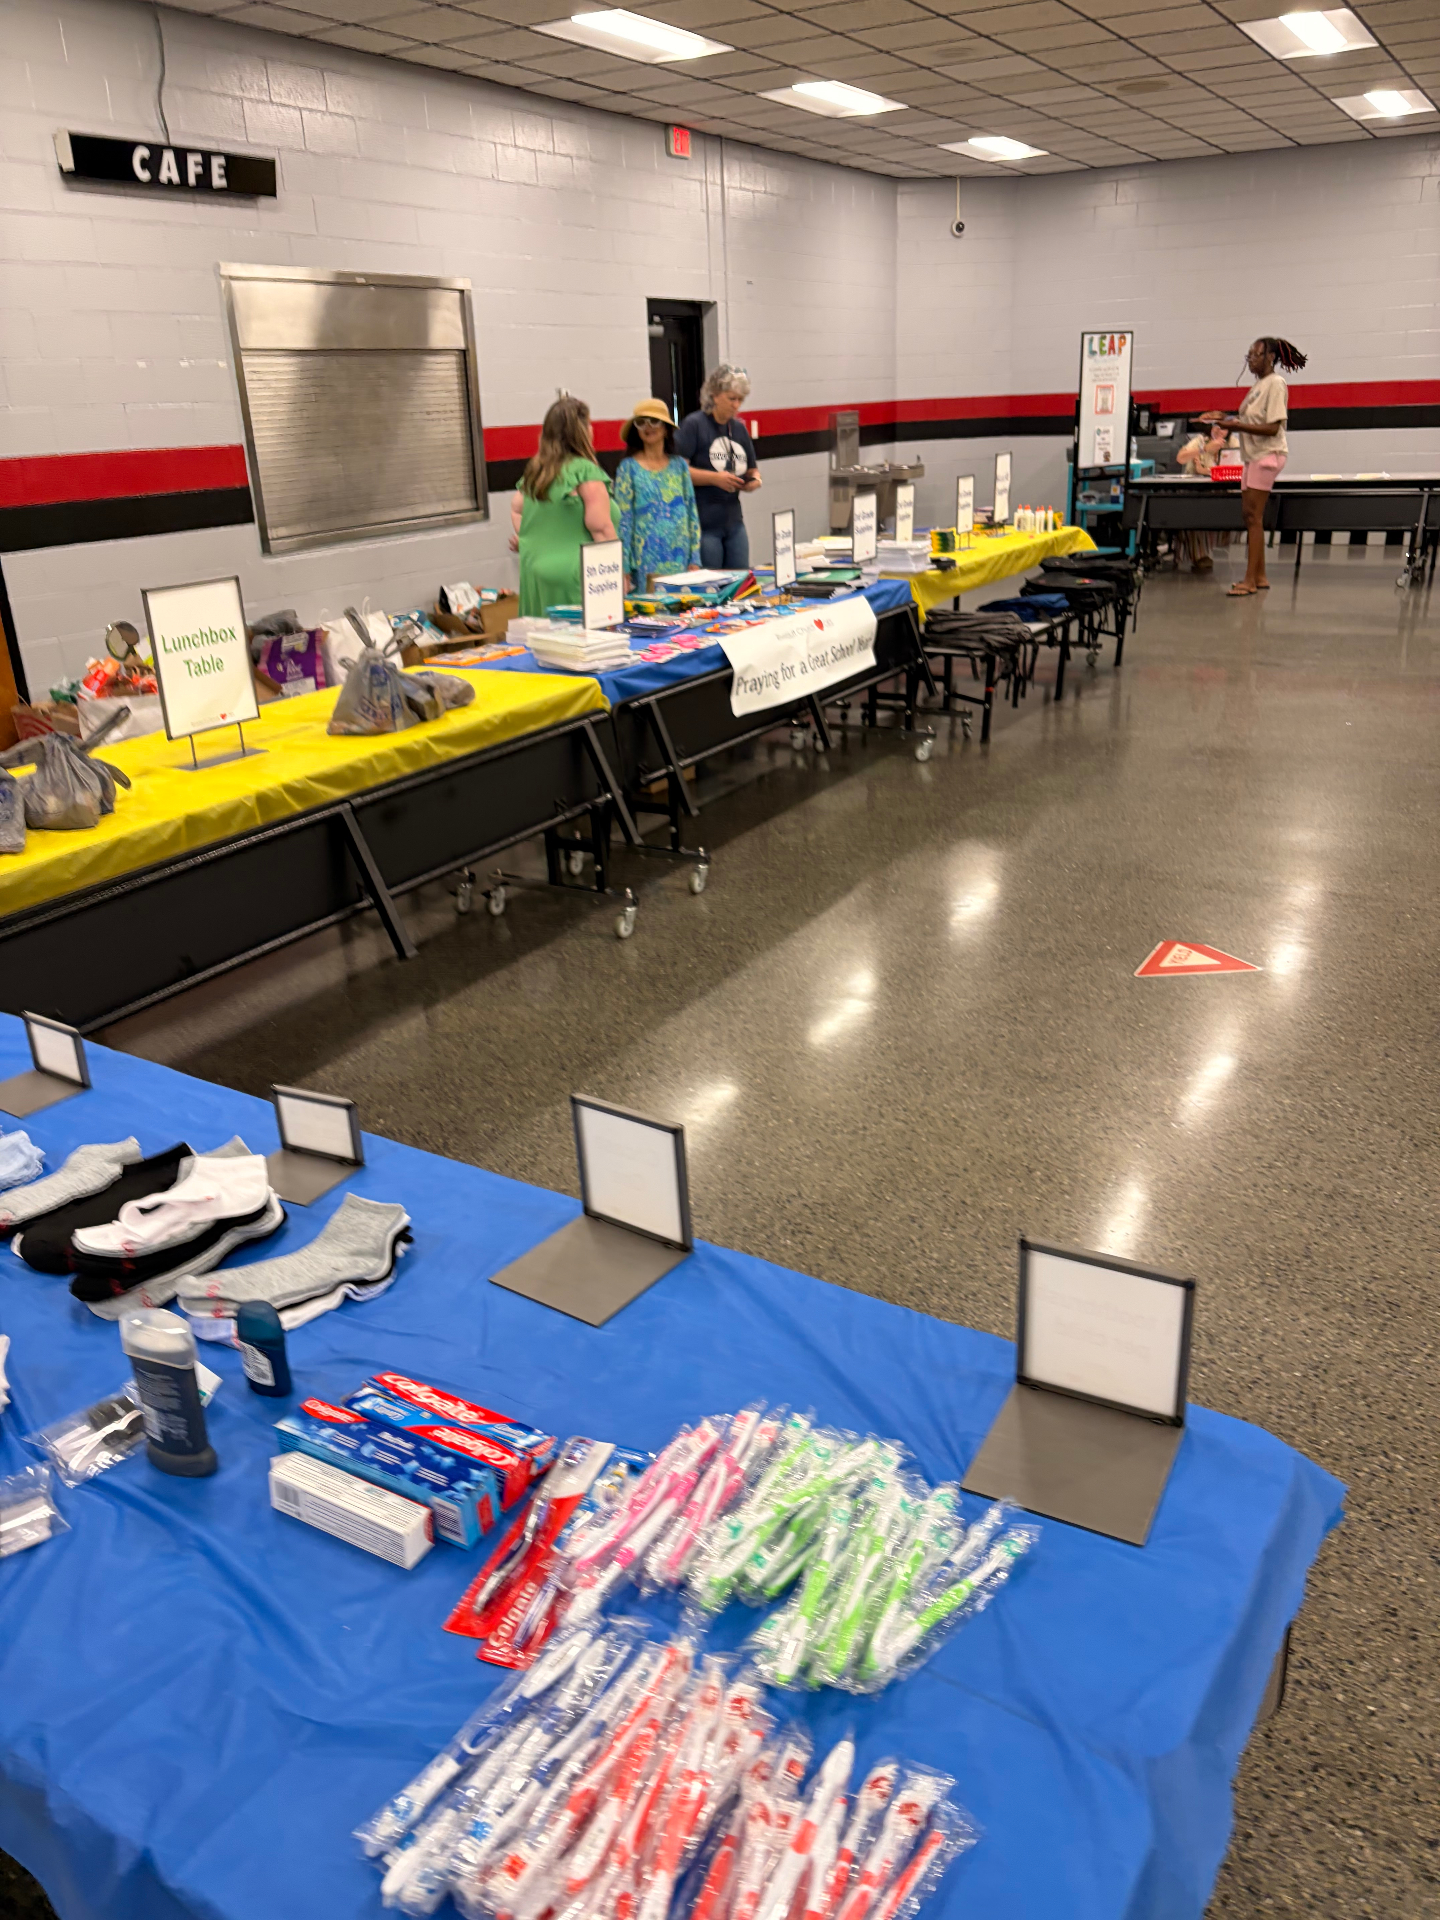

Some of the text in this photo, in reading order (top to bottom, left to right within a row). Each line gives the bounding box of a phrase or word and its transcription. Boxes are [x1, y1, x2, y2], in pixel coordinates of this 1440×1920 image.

[132, 145, 228, 189] CAFE
[1088, 333, 1127, 356] LEAP
[161, 626, 238, 655] Lunchbox
[183, 654, 226, 680] Table
[735, 670, 780, 696] Praying
[781, 662, 797, 681] for
[800, 661, 808, 676] a
[383, 1374, 484, 1425] Colgate
[428, 1426, 515, 1467] Colgate
